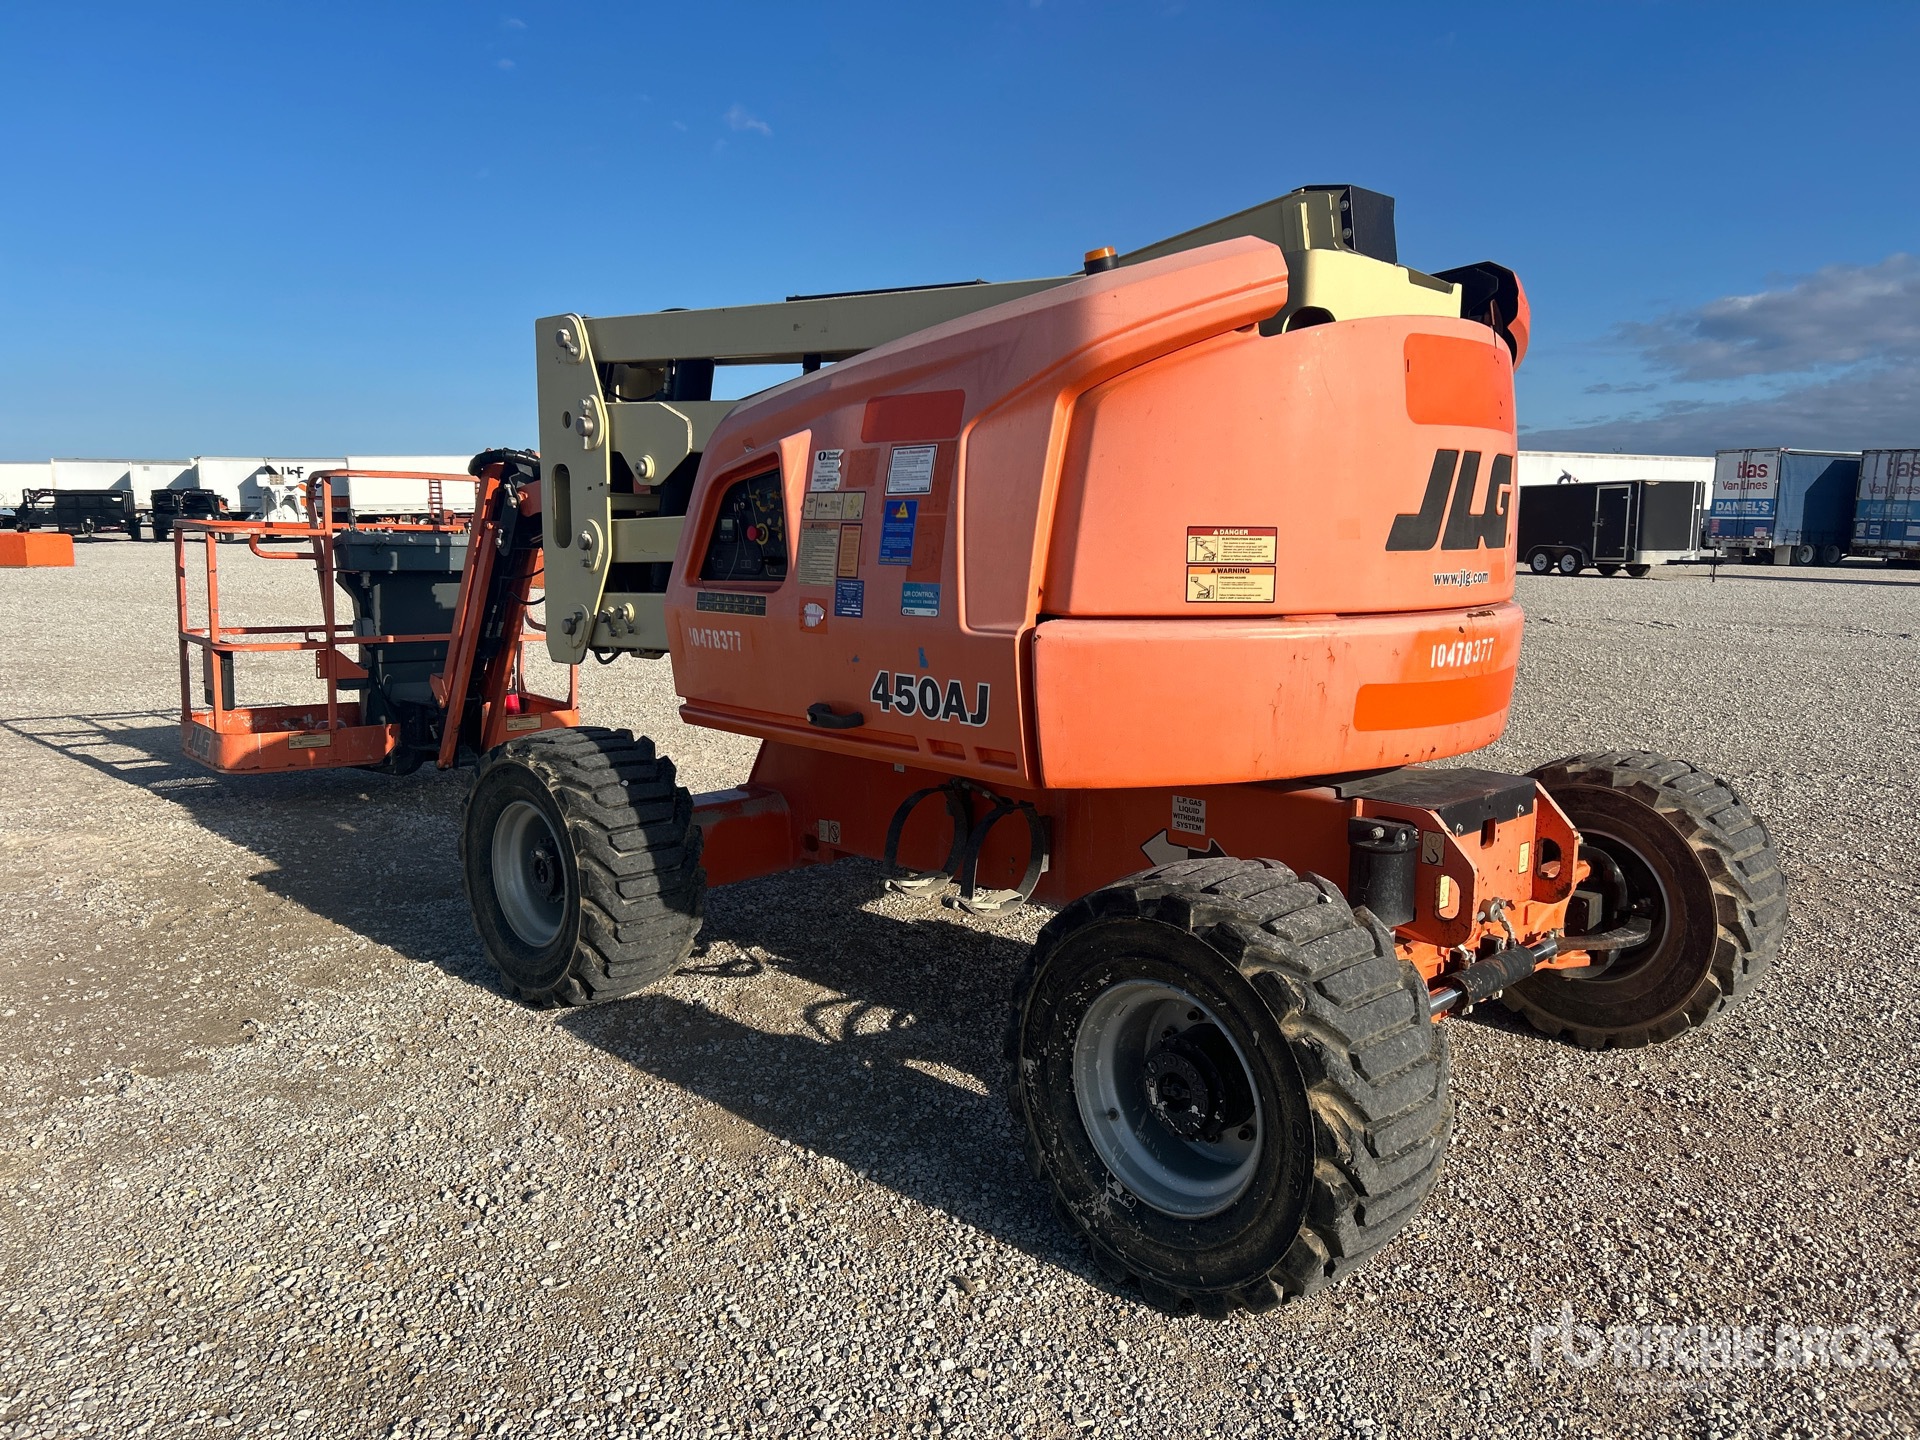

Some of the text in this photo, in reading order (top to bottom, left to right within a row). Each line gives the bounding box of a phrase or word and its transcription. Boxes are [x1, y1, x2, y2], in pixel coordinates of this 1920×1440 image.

[1722, 479, 1768, 491] Van Lines
[1385, 448, 1513, 551] JLG
[1433, 570, 1489, 587] www.jlg.com
[688, 627, 742, 652] 10478377
[1430, 637, 1496, 669] 10478377
[870, 669, 991, 728] 450AJ
[1178, 804, 1200, 815] LIQUID
[1189, 798, 1202, 807] GAS
[1172, 811, 1205, 824] WITHDRAW
[1176, 820, 1202, 832] SYSTEM
